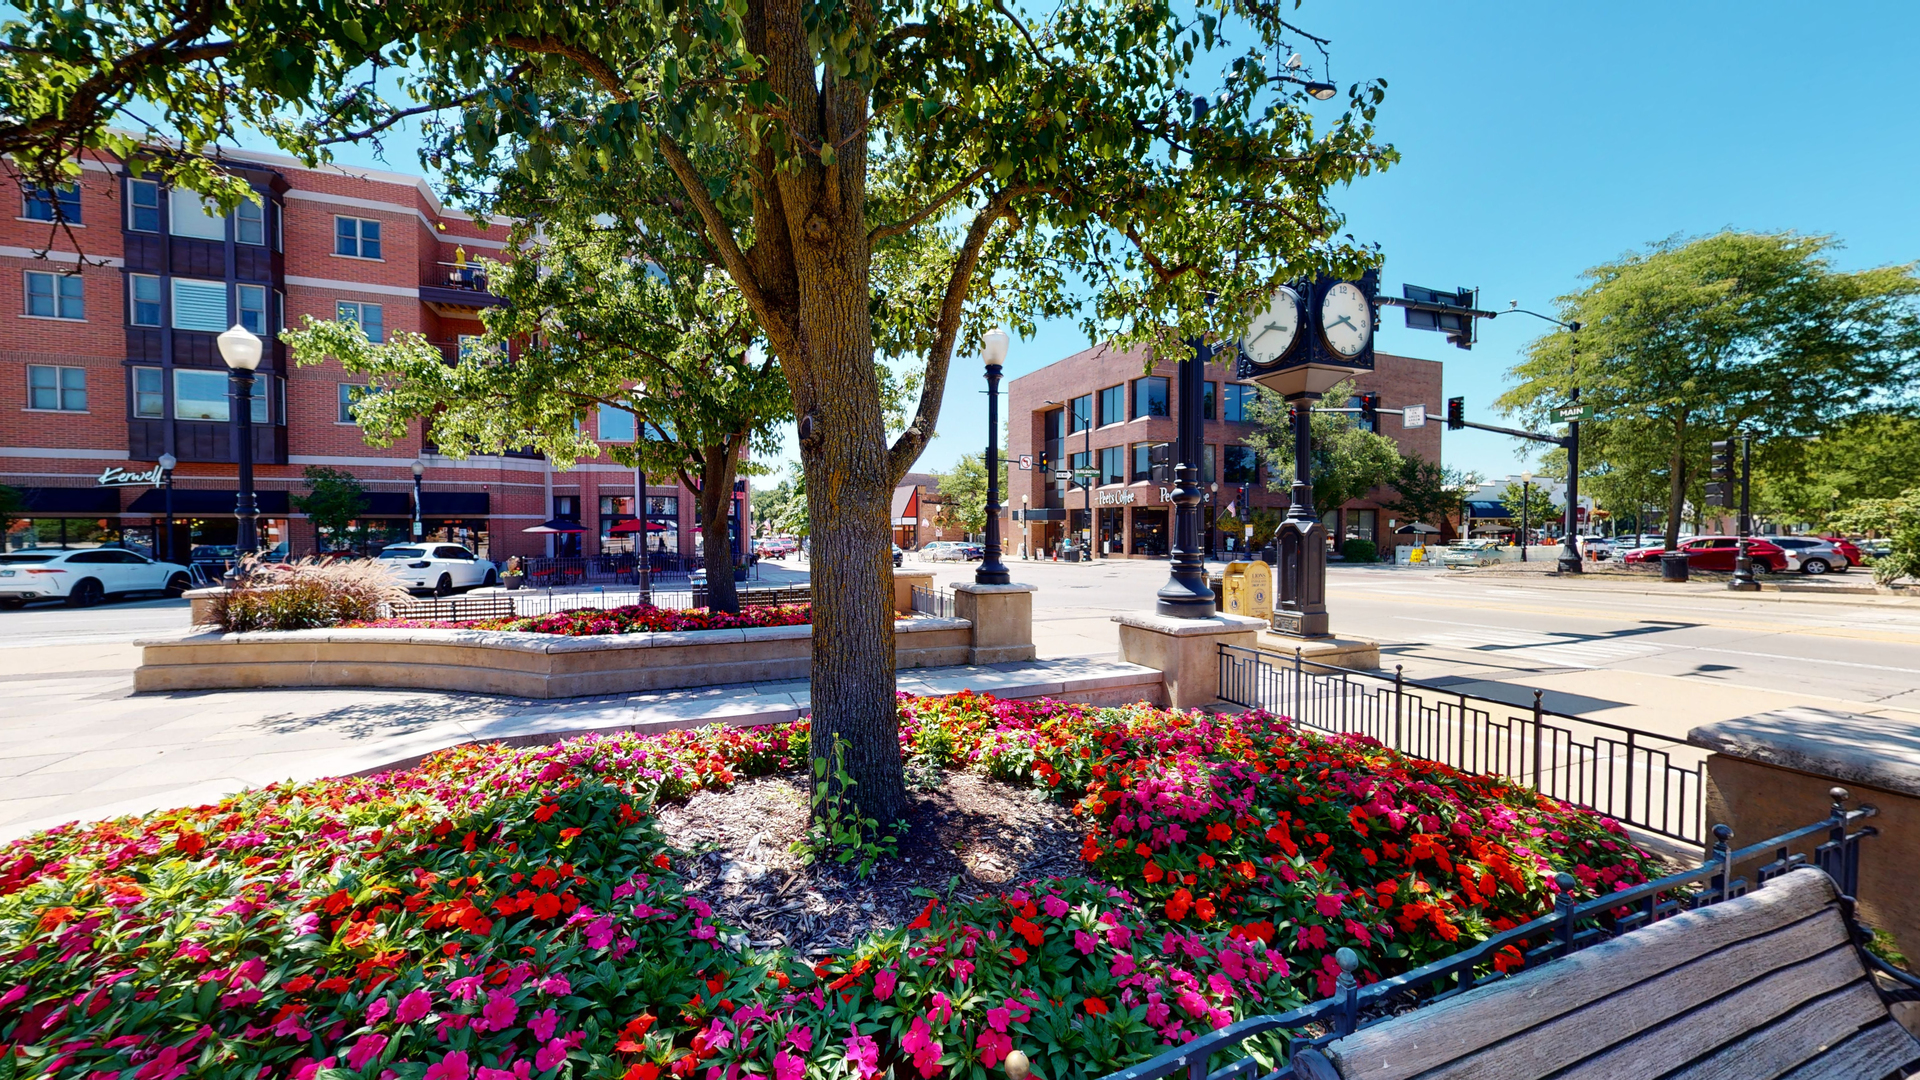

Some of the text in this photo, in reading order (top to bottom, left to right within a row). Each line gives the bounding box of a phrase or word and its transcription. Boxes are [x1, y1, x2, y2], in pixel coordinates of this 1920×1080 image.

[1329, 288, 1336, 296] 11
[1340, 286, 1347, 294] 12
[1290, 301, 1296, 309] 2
[1358, 303, 1364, 311] 2
[1361, 320, 1366, 328] 3
[1358, 333, 1363, 341] 4
[1248, 344, 1255, 352] 8
[1341, 346, 1346, 354] 6
[1351, 344, 1356, 352] 5
[1257, 353, 1263, 361] 7
[1560, 407, 1584, 417] MAIN
[98, 465, 164, 488] Kerwell
[1099, 489, 1135, 505] Peet's Coffee
